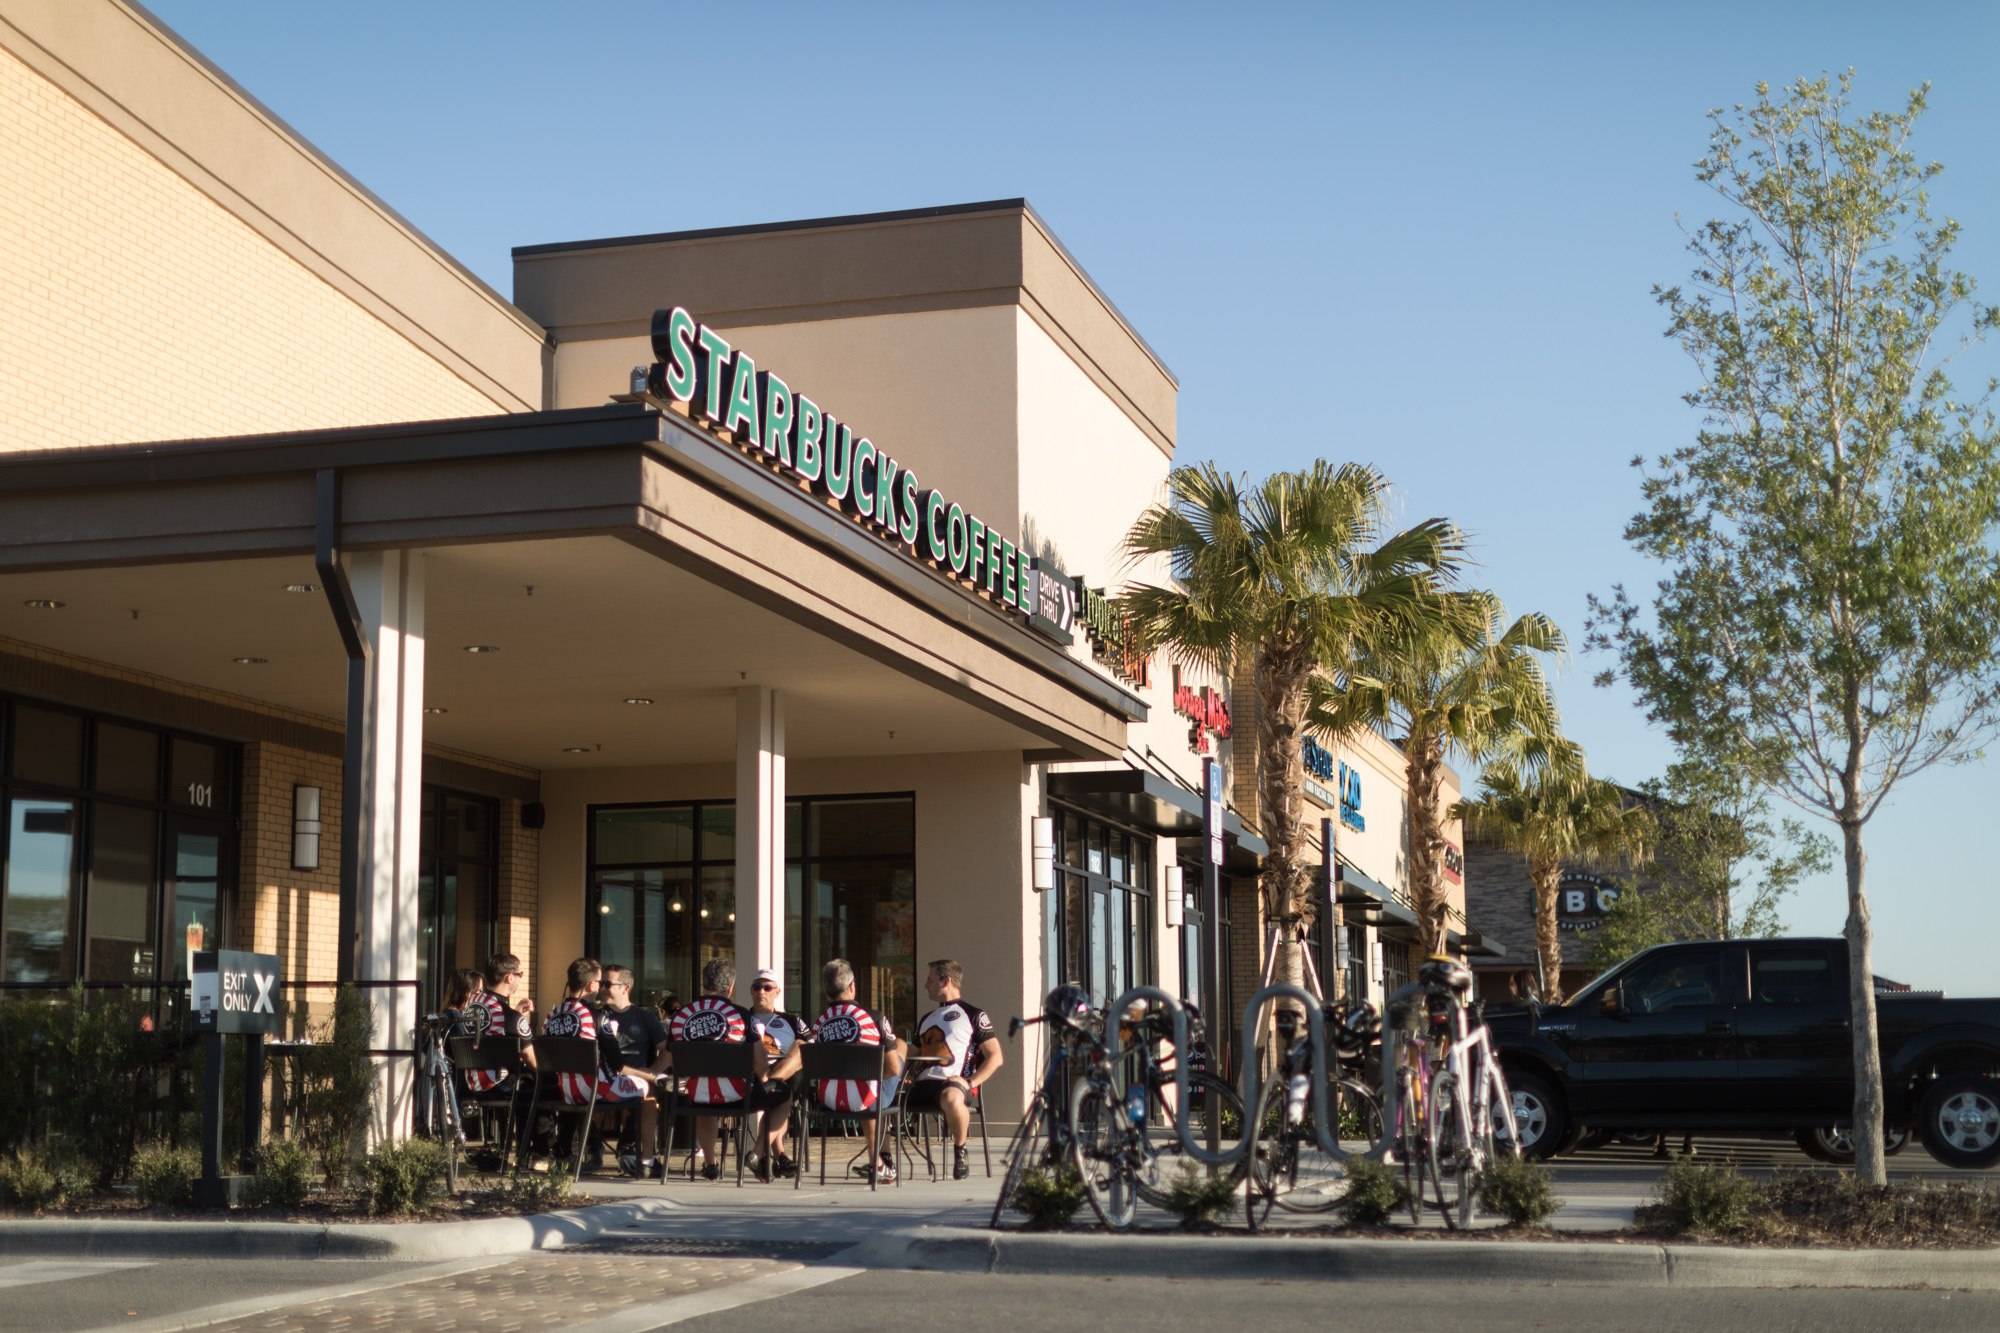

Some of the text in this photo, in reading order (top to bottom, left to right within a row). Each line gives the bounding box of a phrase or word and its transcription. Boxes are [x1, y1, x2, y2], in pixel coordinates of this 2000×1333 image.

[667, 306, 1032, 615] STARBUCKS COFFEE
[1040, 571, 1060, 603] DRIVE
[1040, 594, 1058, 624] THRU
[188, 782, 212, 807] 101
[223, 971, 247, 990] EXIT
[223, 992, 252, 1012] ONLY
[690, 1024, 721, 1039] CREW
